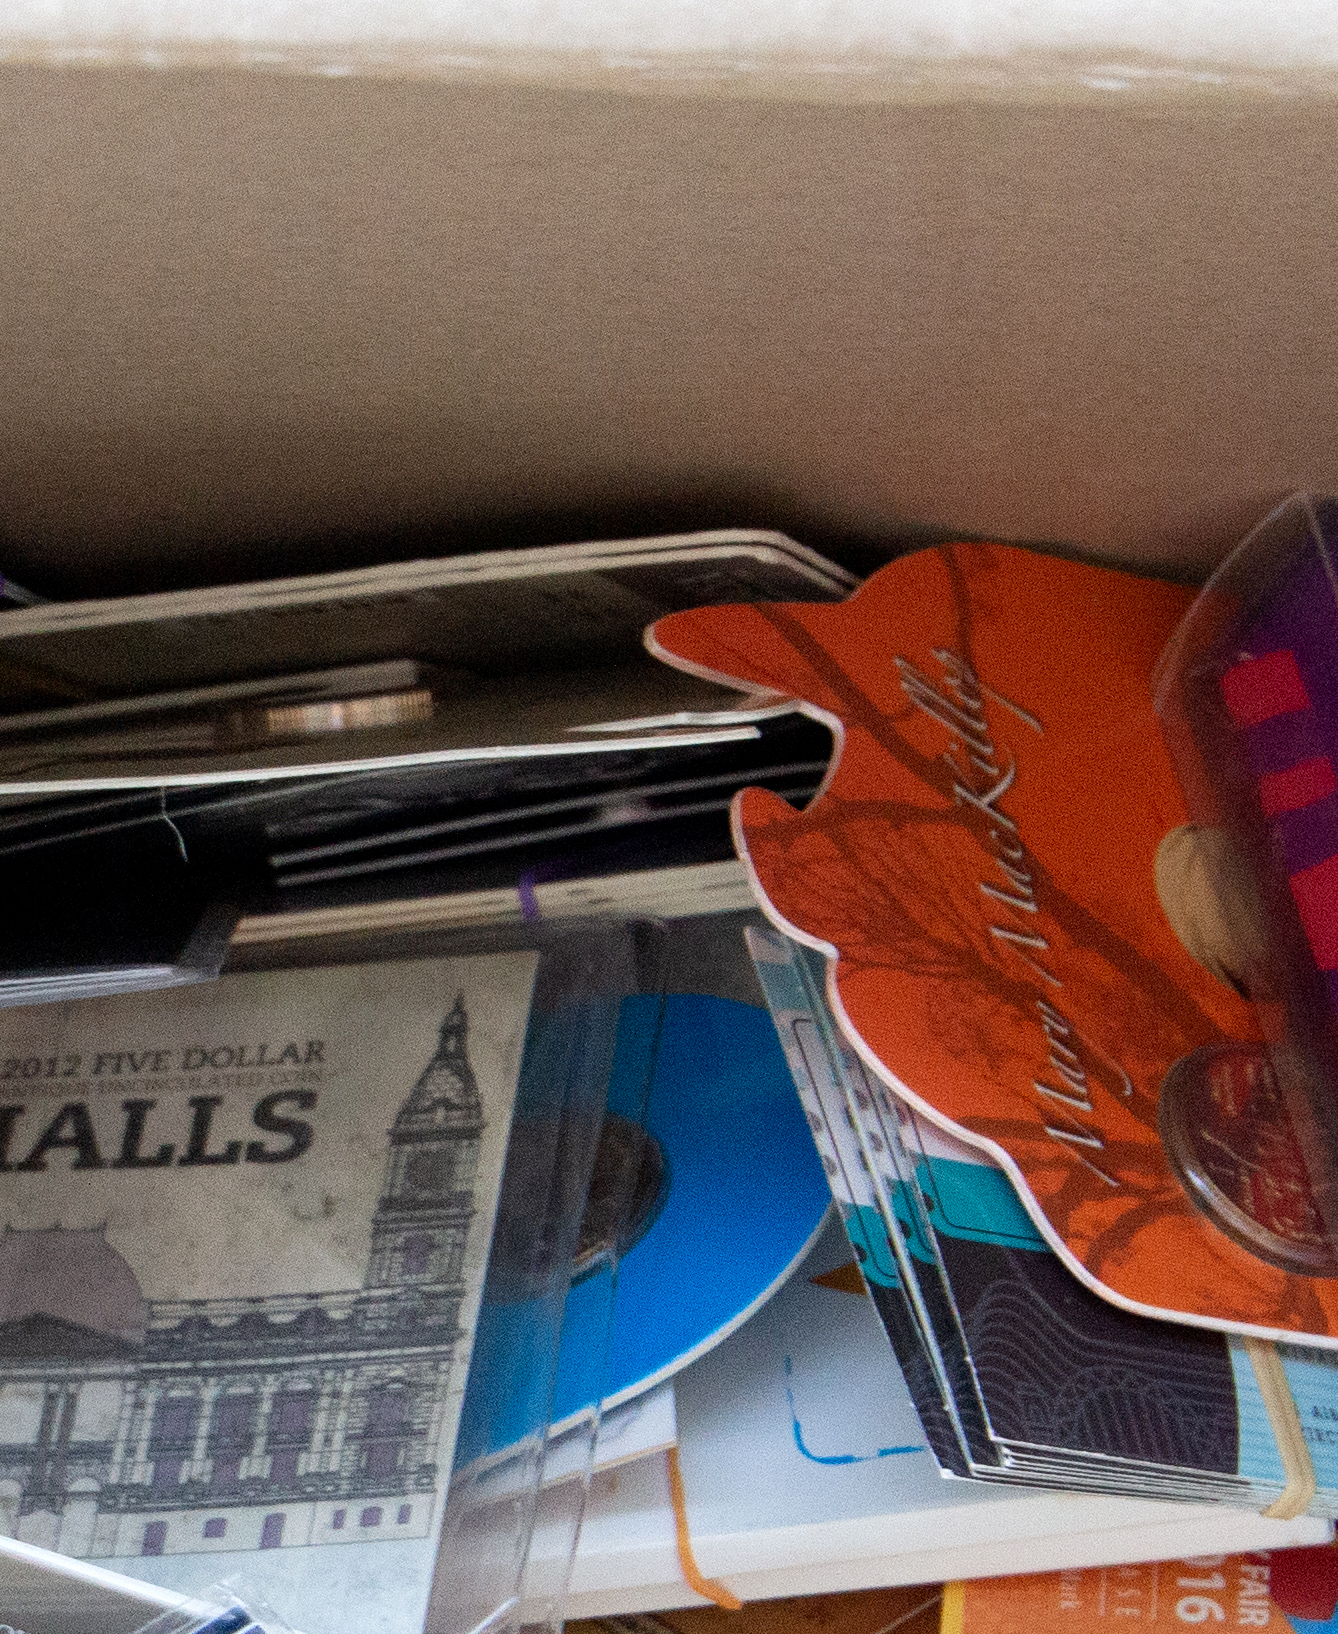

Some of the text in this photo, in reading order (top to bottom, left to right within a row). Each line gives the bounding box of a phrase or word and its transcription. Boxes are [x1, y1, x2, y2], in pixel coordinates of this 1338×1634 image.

[893, 646, 1132, 1186] Mary MacKillop
[0, 1040, 325, 1080] 2012 FIVE DOLLAR
[1238, 1564, 1270, 1627] FAIR
